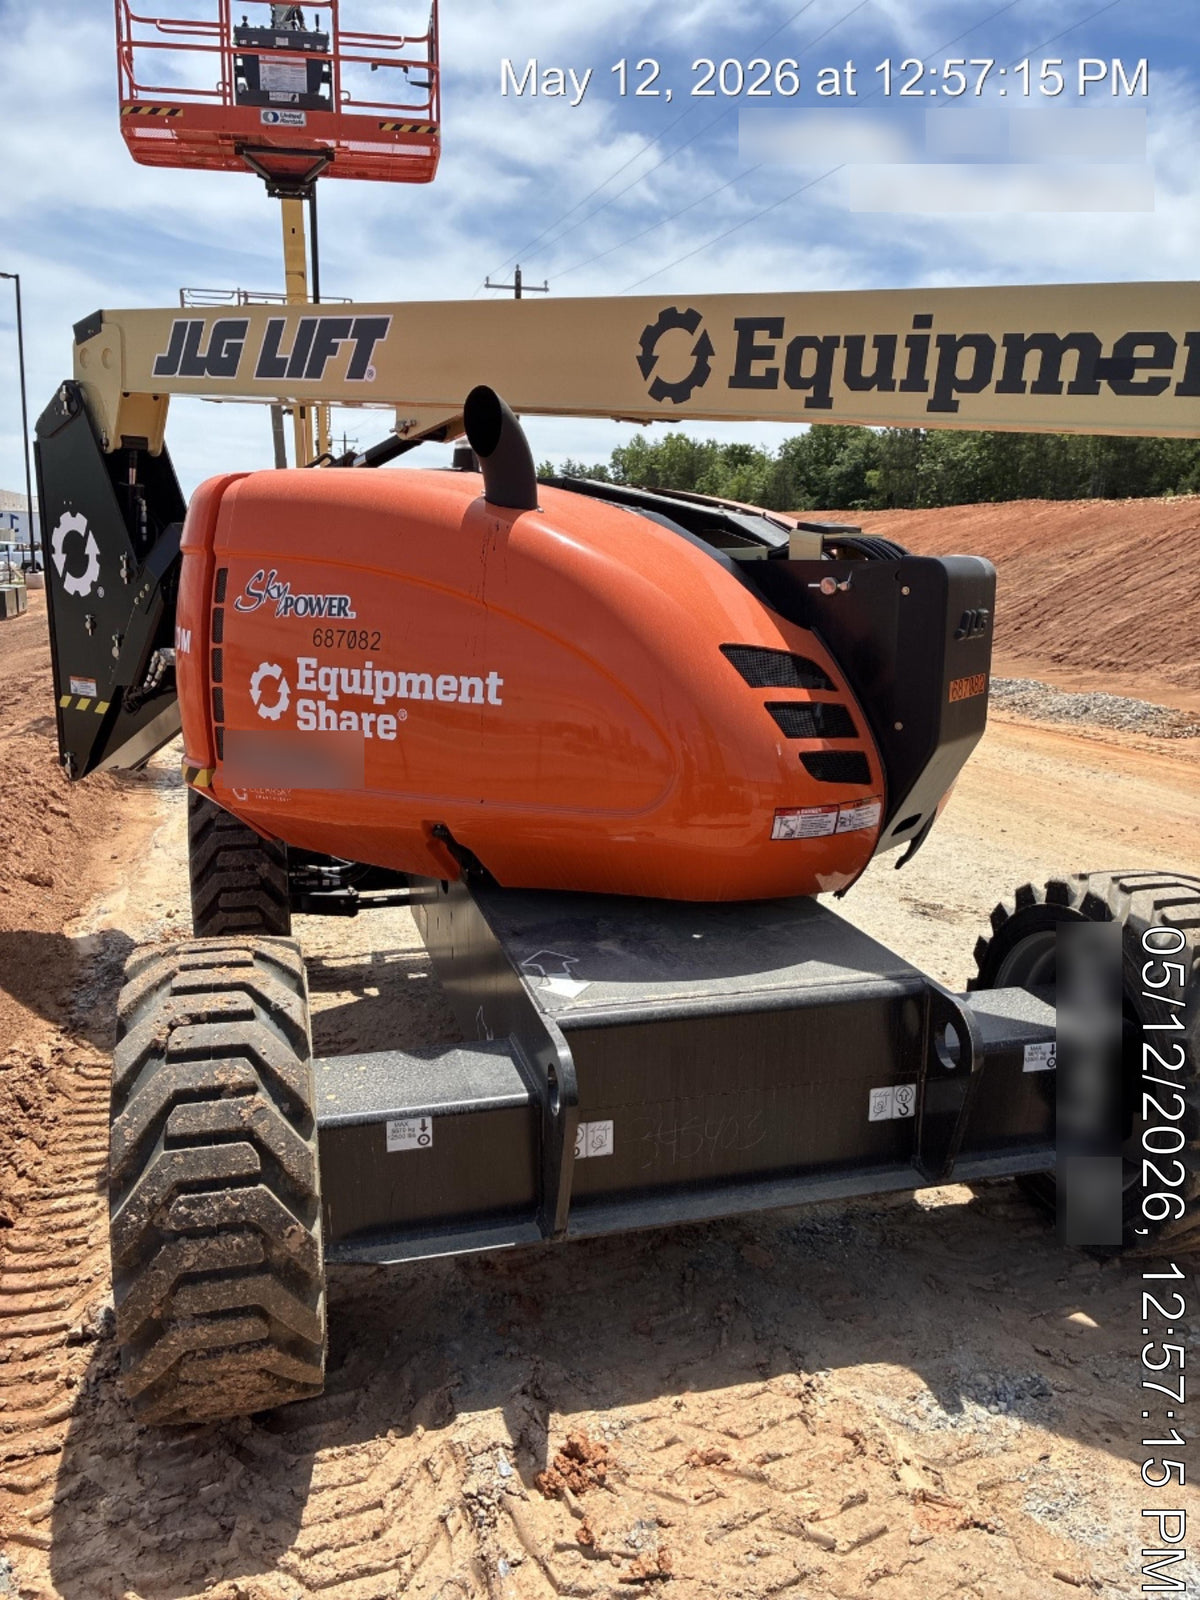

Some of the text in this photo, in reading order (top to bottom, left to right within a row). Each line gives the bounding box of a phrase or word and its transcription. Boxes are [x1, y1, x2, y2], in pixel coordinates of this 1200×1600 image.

[152, 318, 250, 378] JLG
[312, 628, 381, 651] 687082
[296, 656, 504, 706] Equipment
